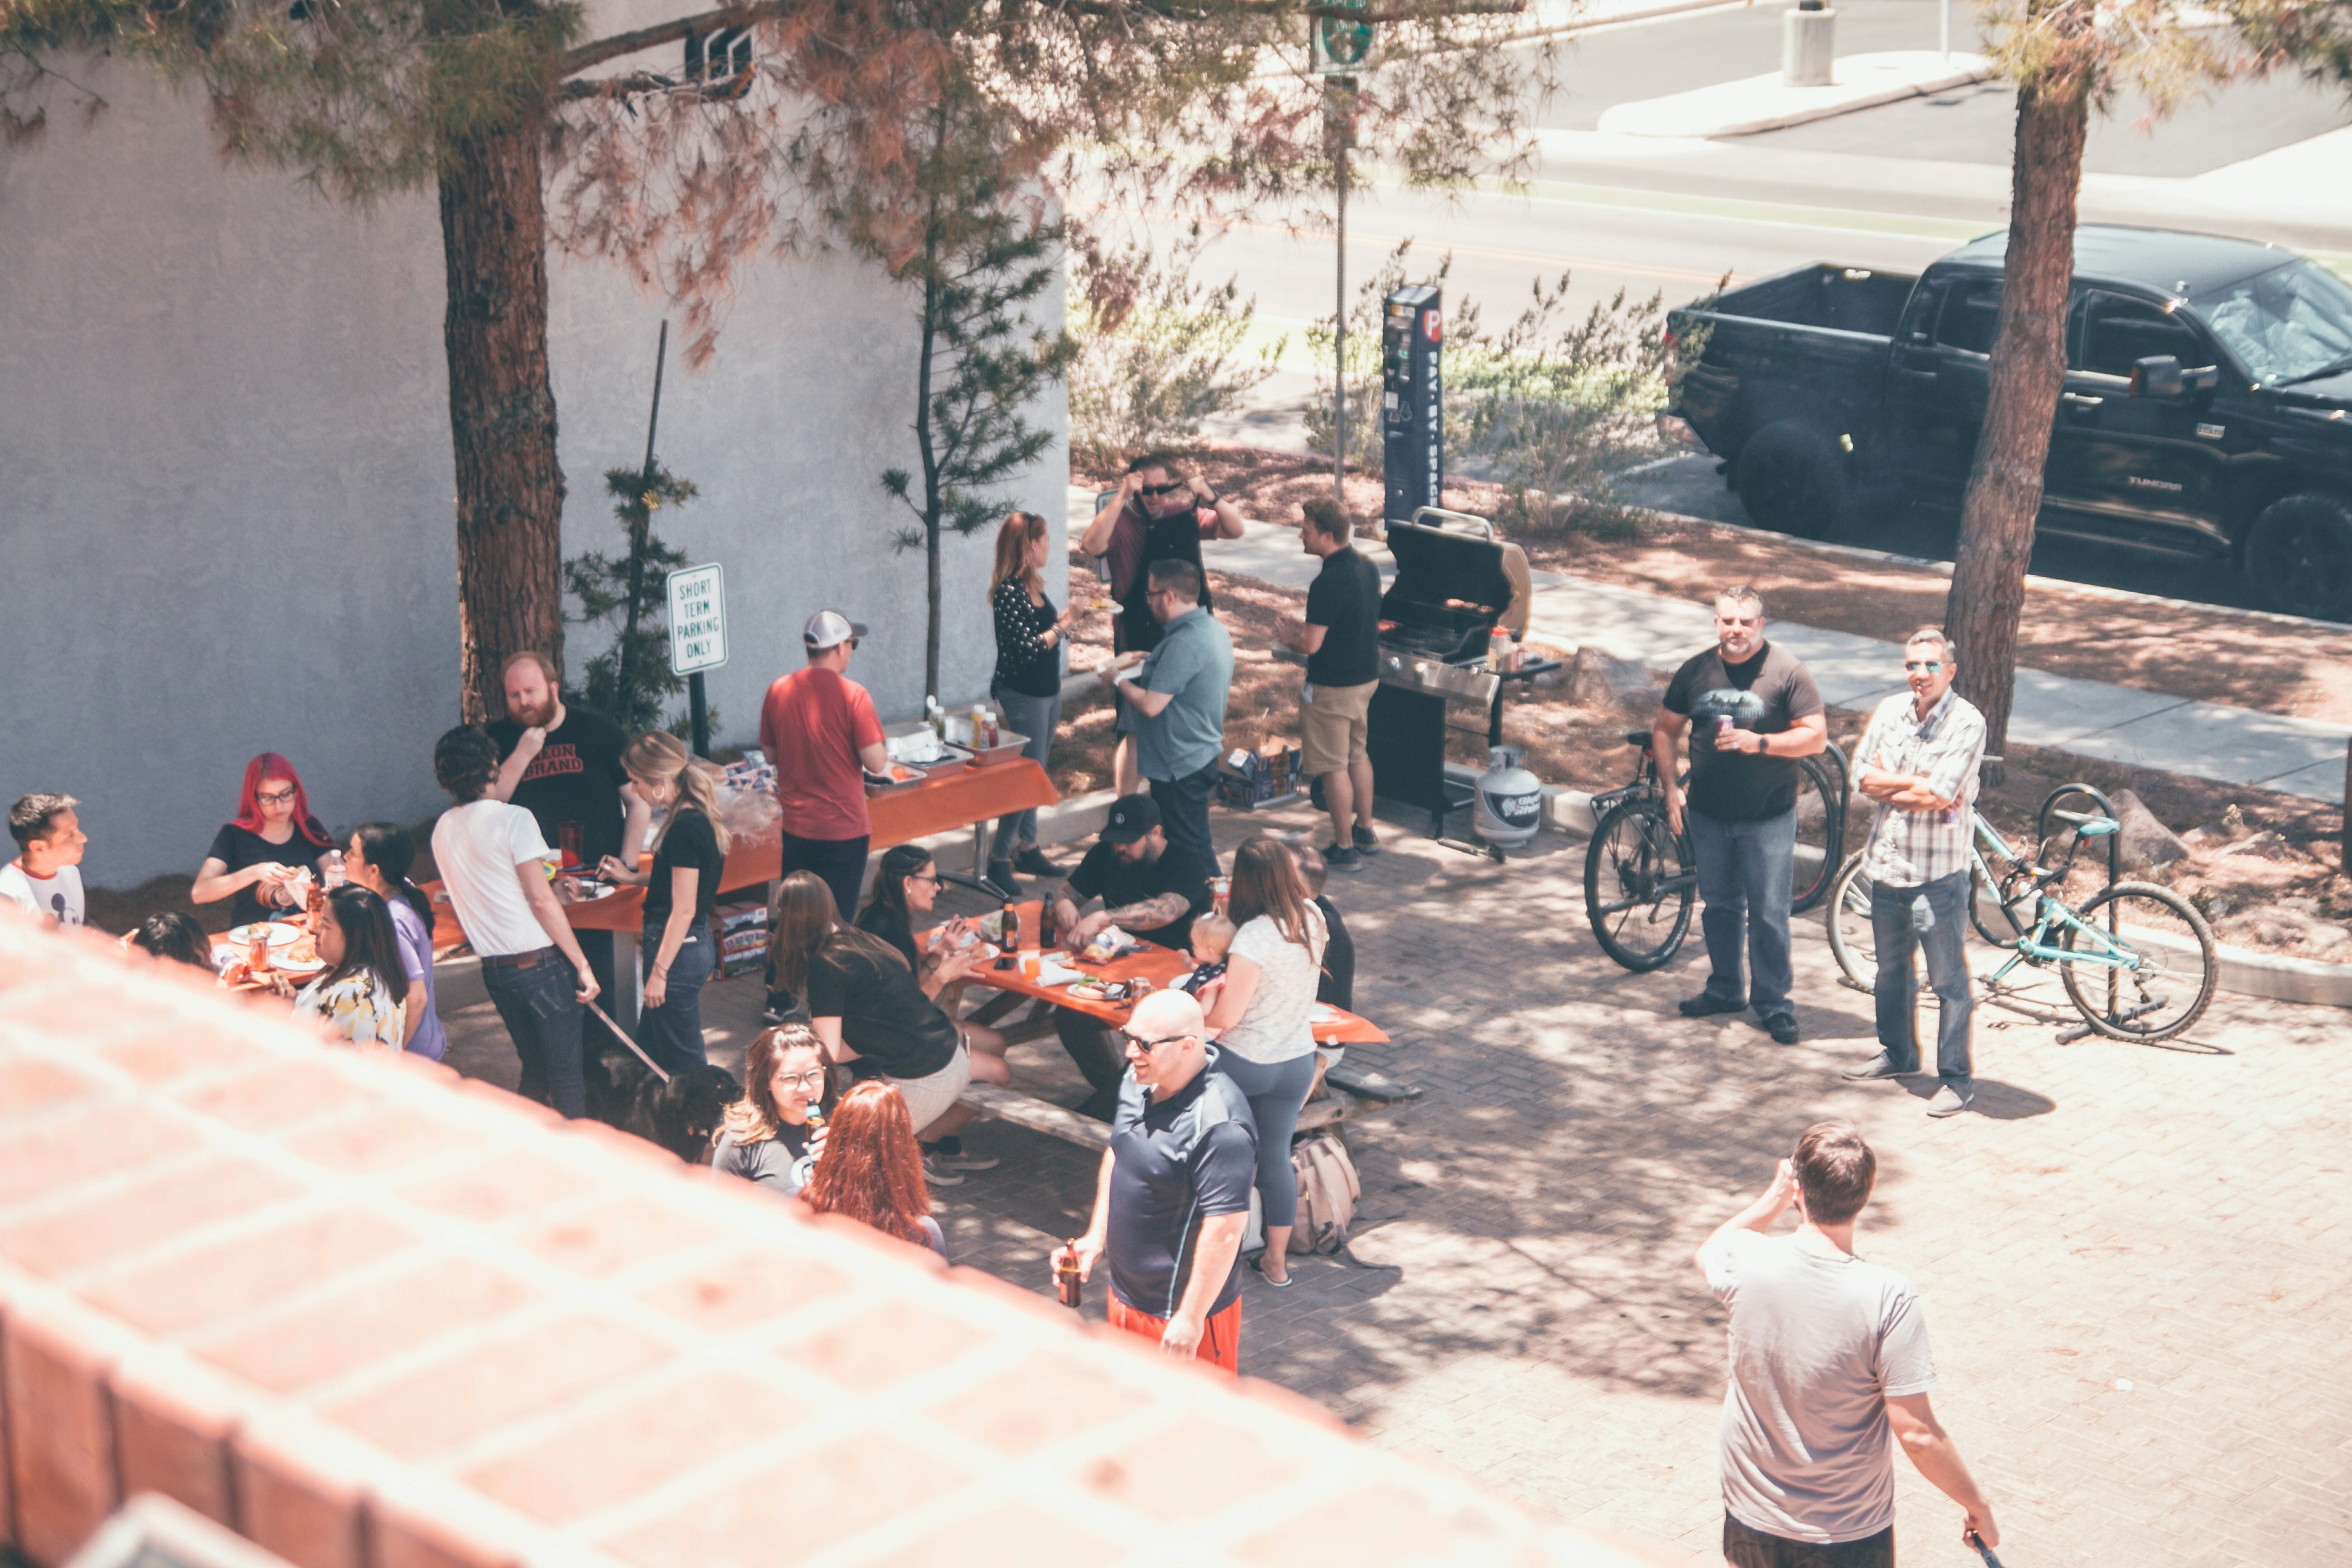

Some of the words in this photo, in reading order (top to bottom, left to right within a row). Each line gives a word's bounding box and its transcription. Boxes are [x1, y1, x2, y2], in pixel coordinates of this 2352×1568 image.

[1428, 310, 1440, 337] P
[679, 579, 711, 600] SHORT
[684, 599, 710, 619] TERM
[678, 616, 719, 640] PARKING
[687, 639, 712, 658] ONLY
[524, 759, 581, 777] BRAND
